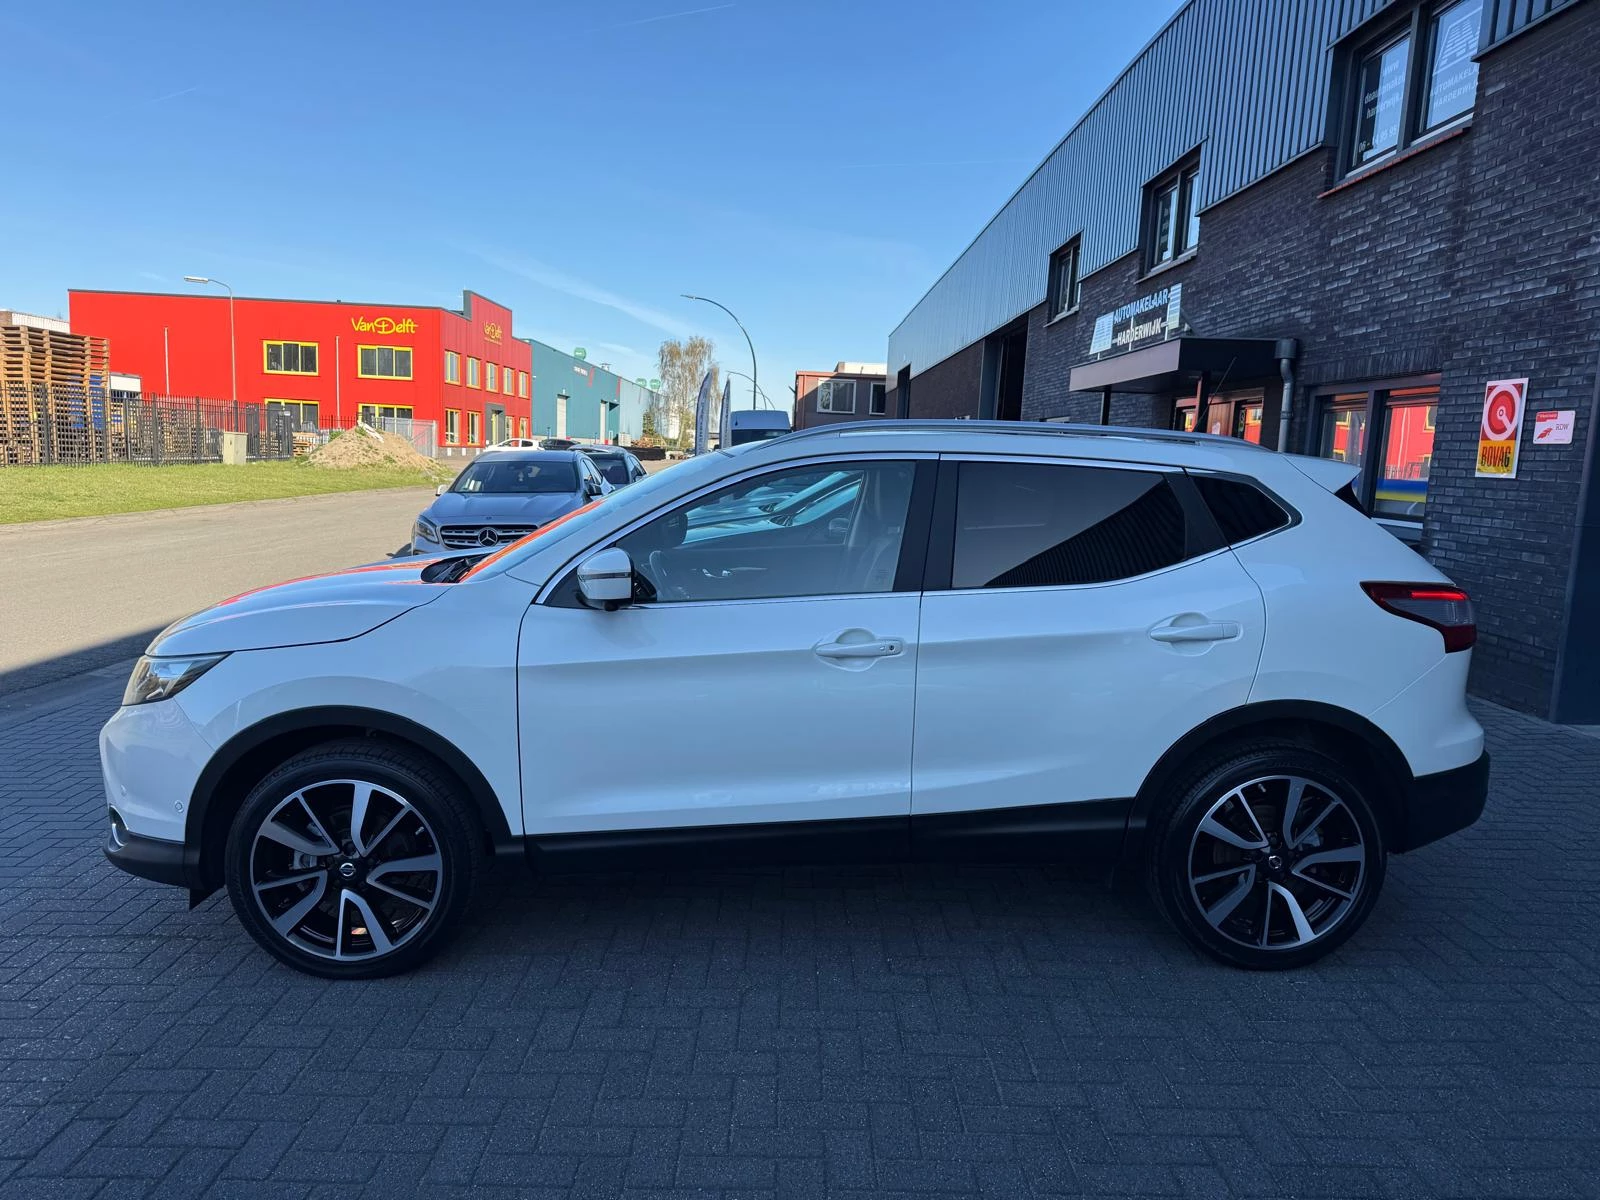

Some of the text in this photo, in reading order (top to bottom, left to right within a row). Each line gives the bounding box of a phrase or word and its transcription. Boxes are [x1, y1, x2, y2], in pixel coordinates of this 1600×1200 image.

[1113, 288, 1169, 324] AUTOMAKELAAR
[1117, 317, 1162, 346] HARDERWIJK
[1481, 446, 1511, 467] BOVAG
